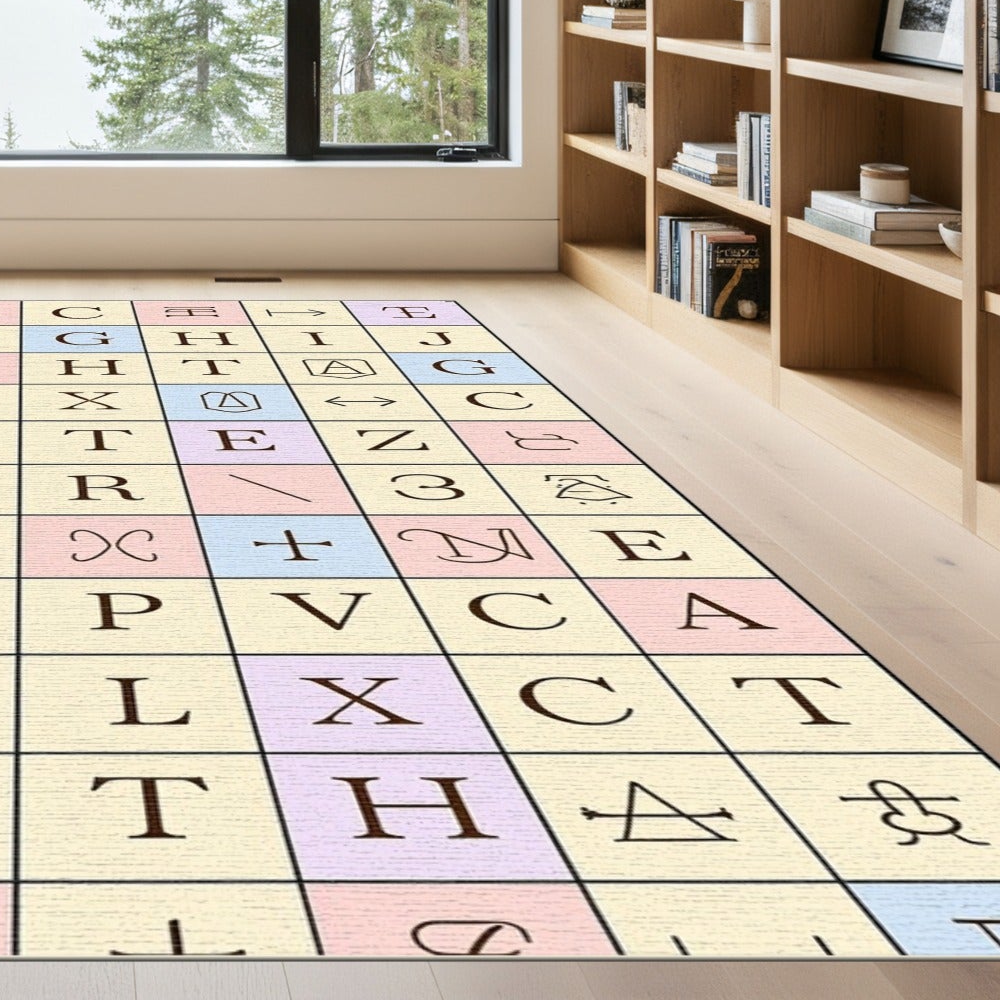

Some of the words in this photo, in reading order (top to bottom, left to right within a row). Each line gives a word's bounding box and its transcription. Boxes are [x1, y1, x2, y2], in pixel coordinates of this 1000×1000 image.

[52, 307, 103, 319] C
[55, 332, 110, 345] G
[170, 332, 238, 345] H
[301, 332, 333, 345] I
[419, 332, 451, 346] J
[56, 360, 126, 375] H
[181, 360, 240, 375] T
[432, 360, 496, 375] G
[58, 392, 121, 410] X
[466, 392, 533, 410] C
[64, 430, 133, 451] T
[207, 430, 276, 451] E
[356, 430, 430, 451] Z
[67, 475, 144, 501] R
[590, 530, 692, 561] E
[87, 593, 163, 630] P
[270, 593, 372, 630] V
[468, 592, 567, 630] C
[677, 592, 779, 630] A
[105, 678, 191, 725] L
[299, 677, 424, 725] X
[519, 677, 634, 726] C
[731, 677, 851, 725] T
[90, 776, 209, 839] T
[331, 777, 499, 839] H
